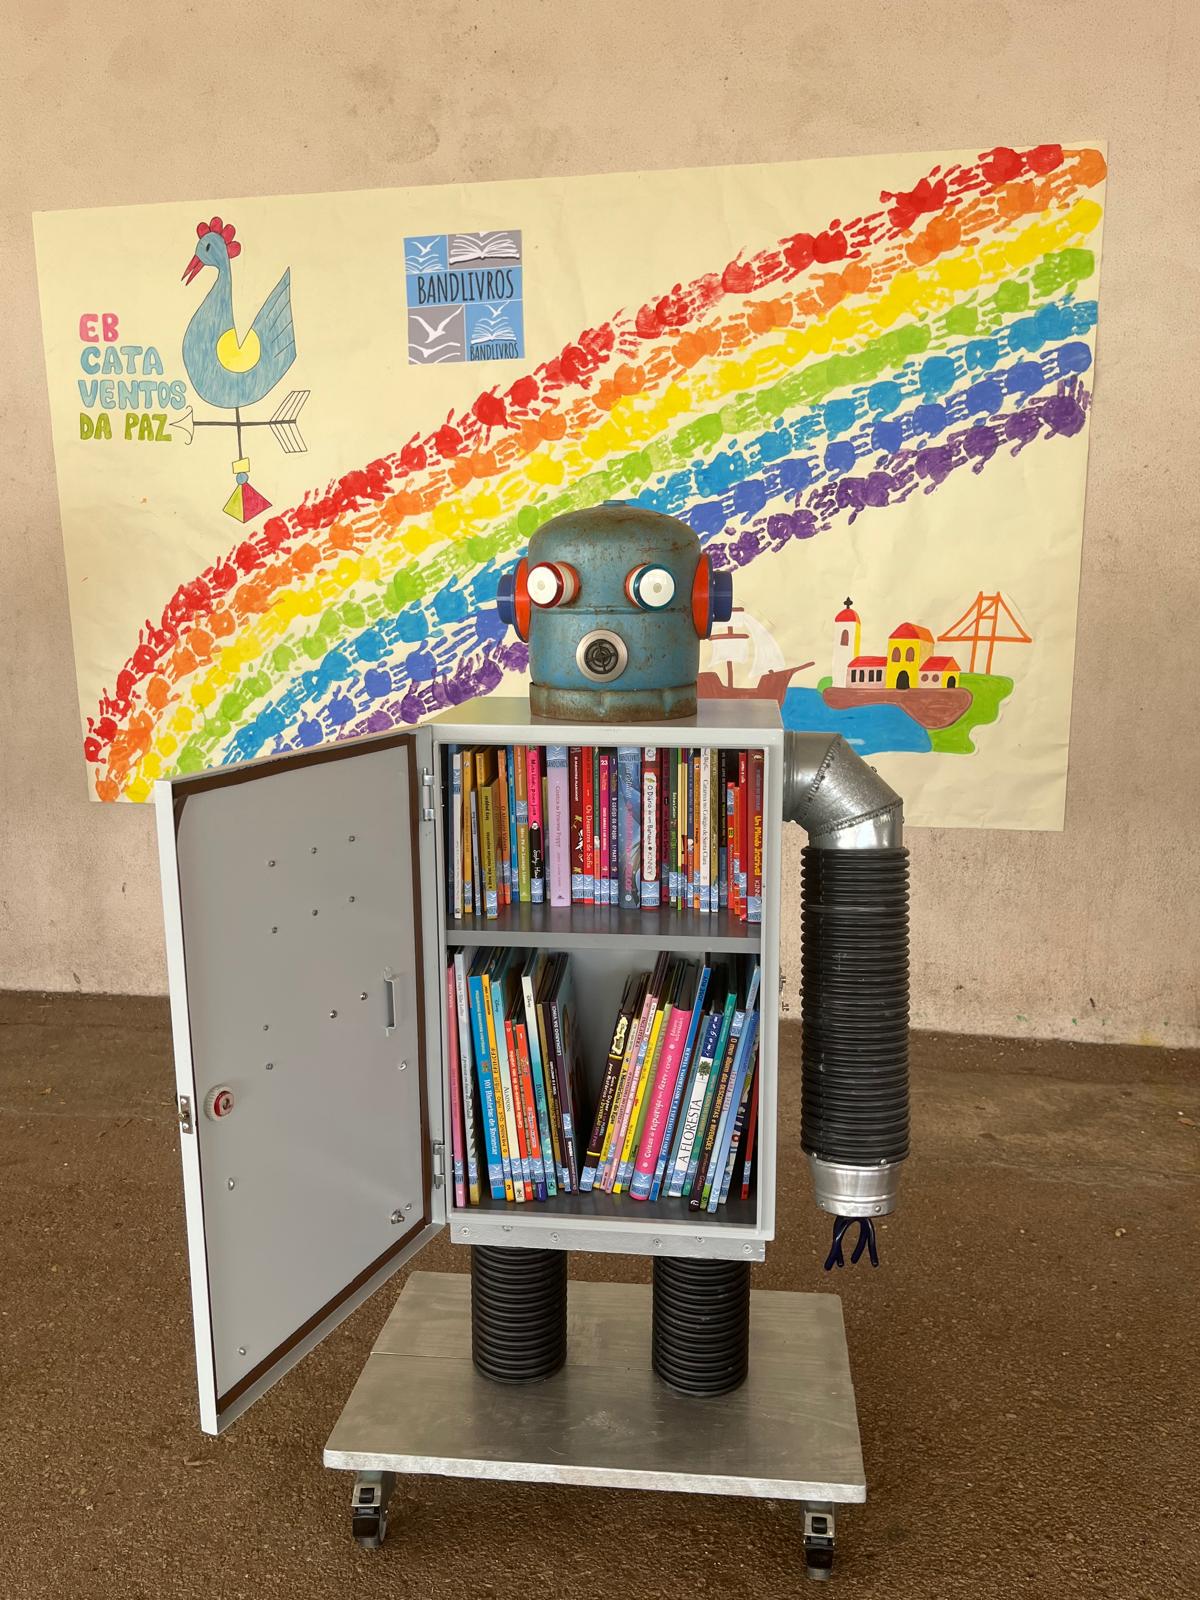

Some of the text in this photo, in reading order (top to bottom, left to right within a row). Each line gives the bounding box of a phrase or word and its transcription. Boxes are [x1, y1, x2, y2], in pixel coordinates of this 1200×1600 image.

[417, 269, 514, 305] BANDLIVROS
[79, 313, 119, 343] EB
[80, 345, 164, 375] CATA
[469, 341, 519, 362] BANDLIVROS
[78, 379, 187, 409] VENTOS
[79, 413, 173, 441] DA PAZ
[585, 852, 593, 868] Sofia
[552, 1027, 563, 1056] LEONARDO
[634, 1015, 646, 1048] INGLATERRA
[722, 1056, 733, 1073] álbum
[484, 1089, 494, 1117] Histórias
[711, 1082, 726, 1118] DESCOBERTAS
[488, 1126, 499, 1155] Encantar
[679, 1098, 702, 1154] FLORESTA
[704, 1123, 717, 1151] INVENÇÕES
